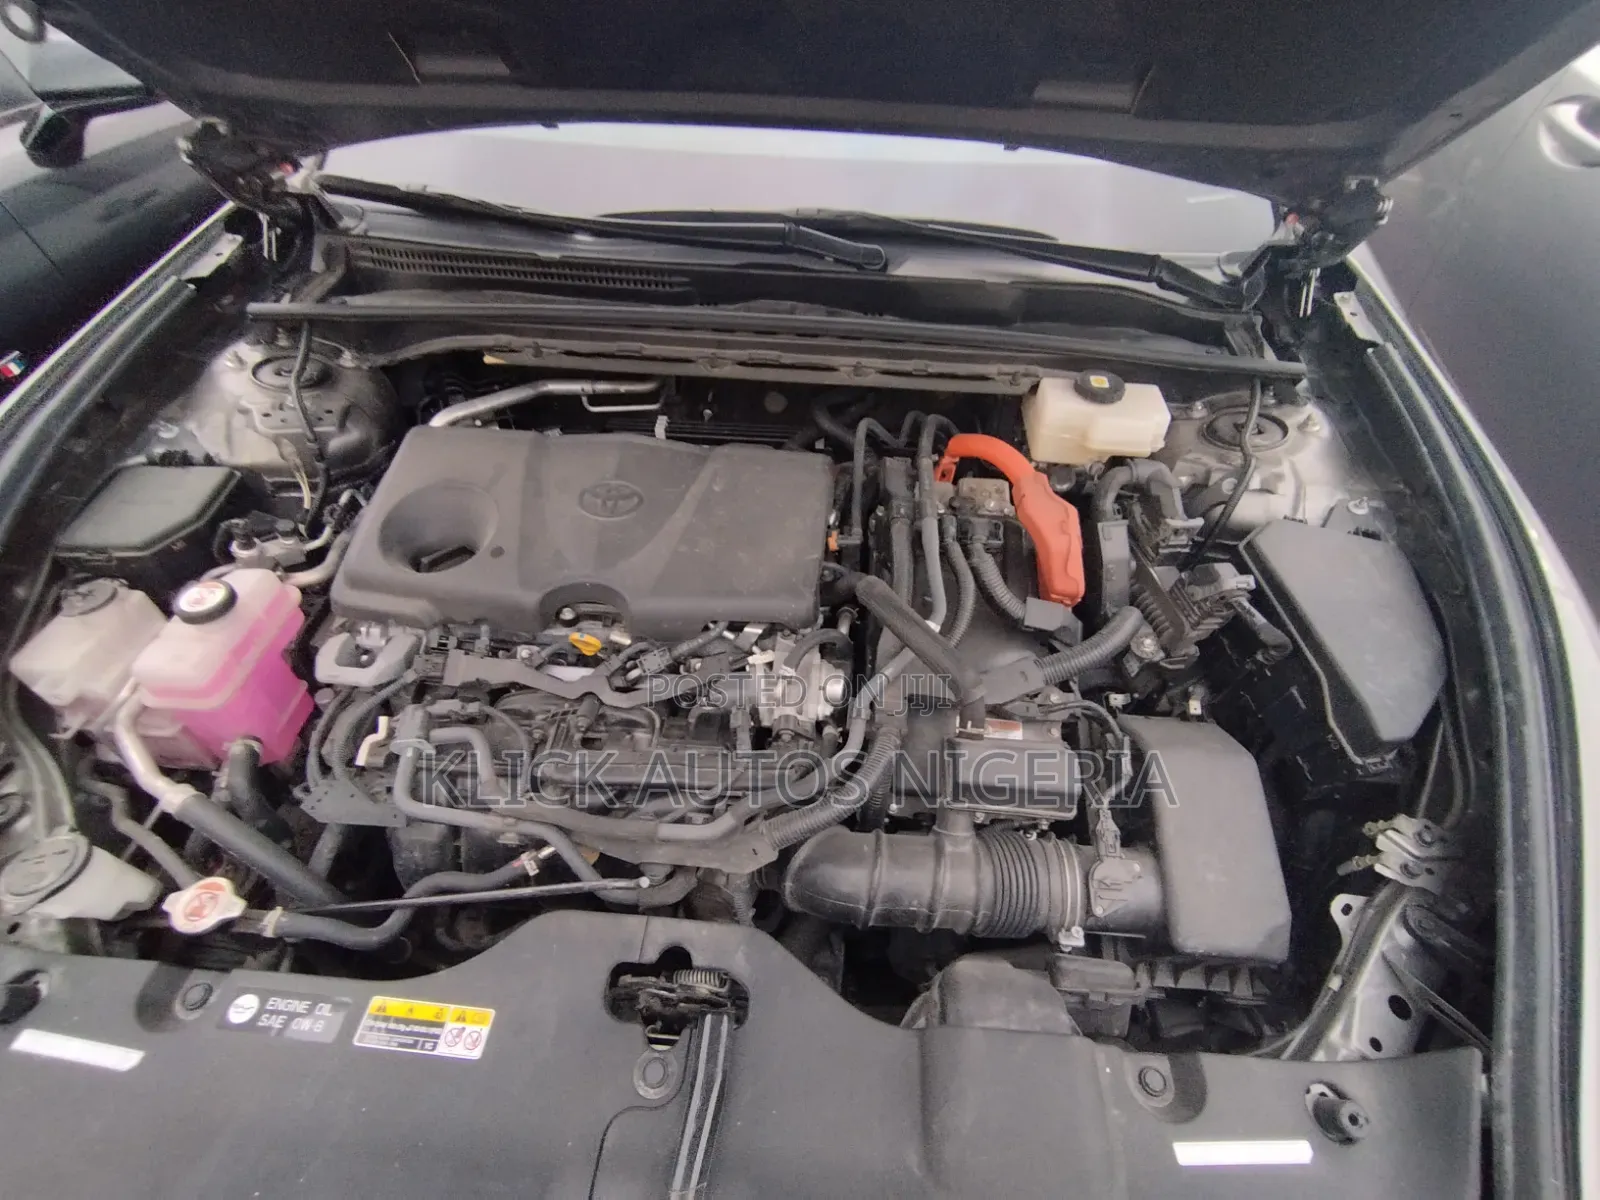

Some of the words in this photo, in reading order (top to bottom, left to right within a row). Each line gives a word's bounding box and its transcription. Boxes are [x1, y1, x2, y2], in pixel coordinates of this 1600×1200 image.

[265, 998, 311, 1013] ENGINE
[314, 1003, 333, 1016] OIL
[258, 1014, 286, 1028] SAE
